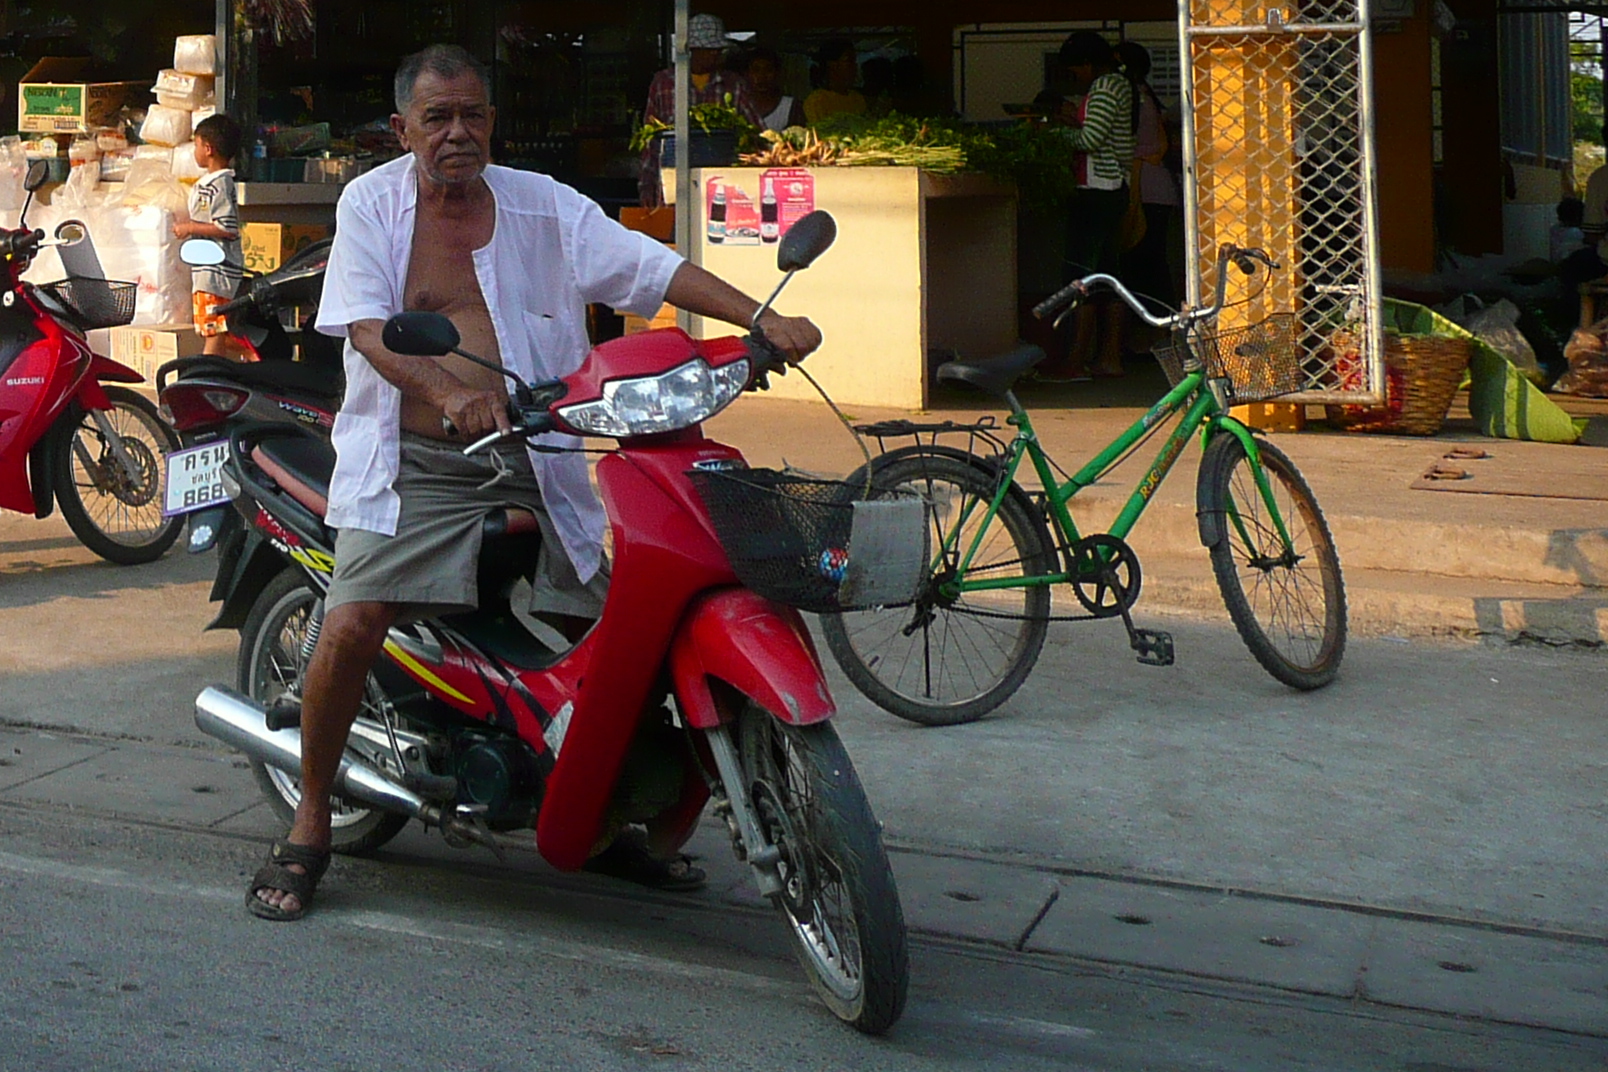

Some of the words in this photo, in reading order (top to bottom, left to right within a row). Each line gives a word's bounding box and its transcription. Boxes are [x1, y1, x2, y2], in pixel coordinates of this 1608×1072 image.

[6, 377, 45, 385] SUZUKI
[279, 401, 318, 418] Wave
[183, 483, 224, 508] 868
